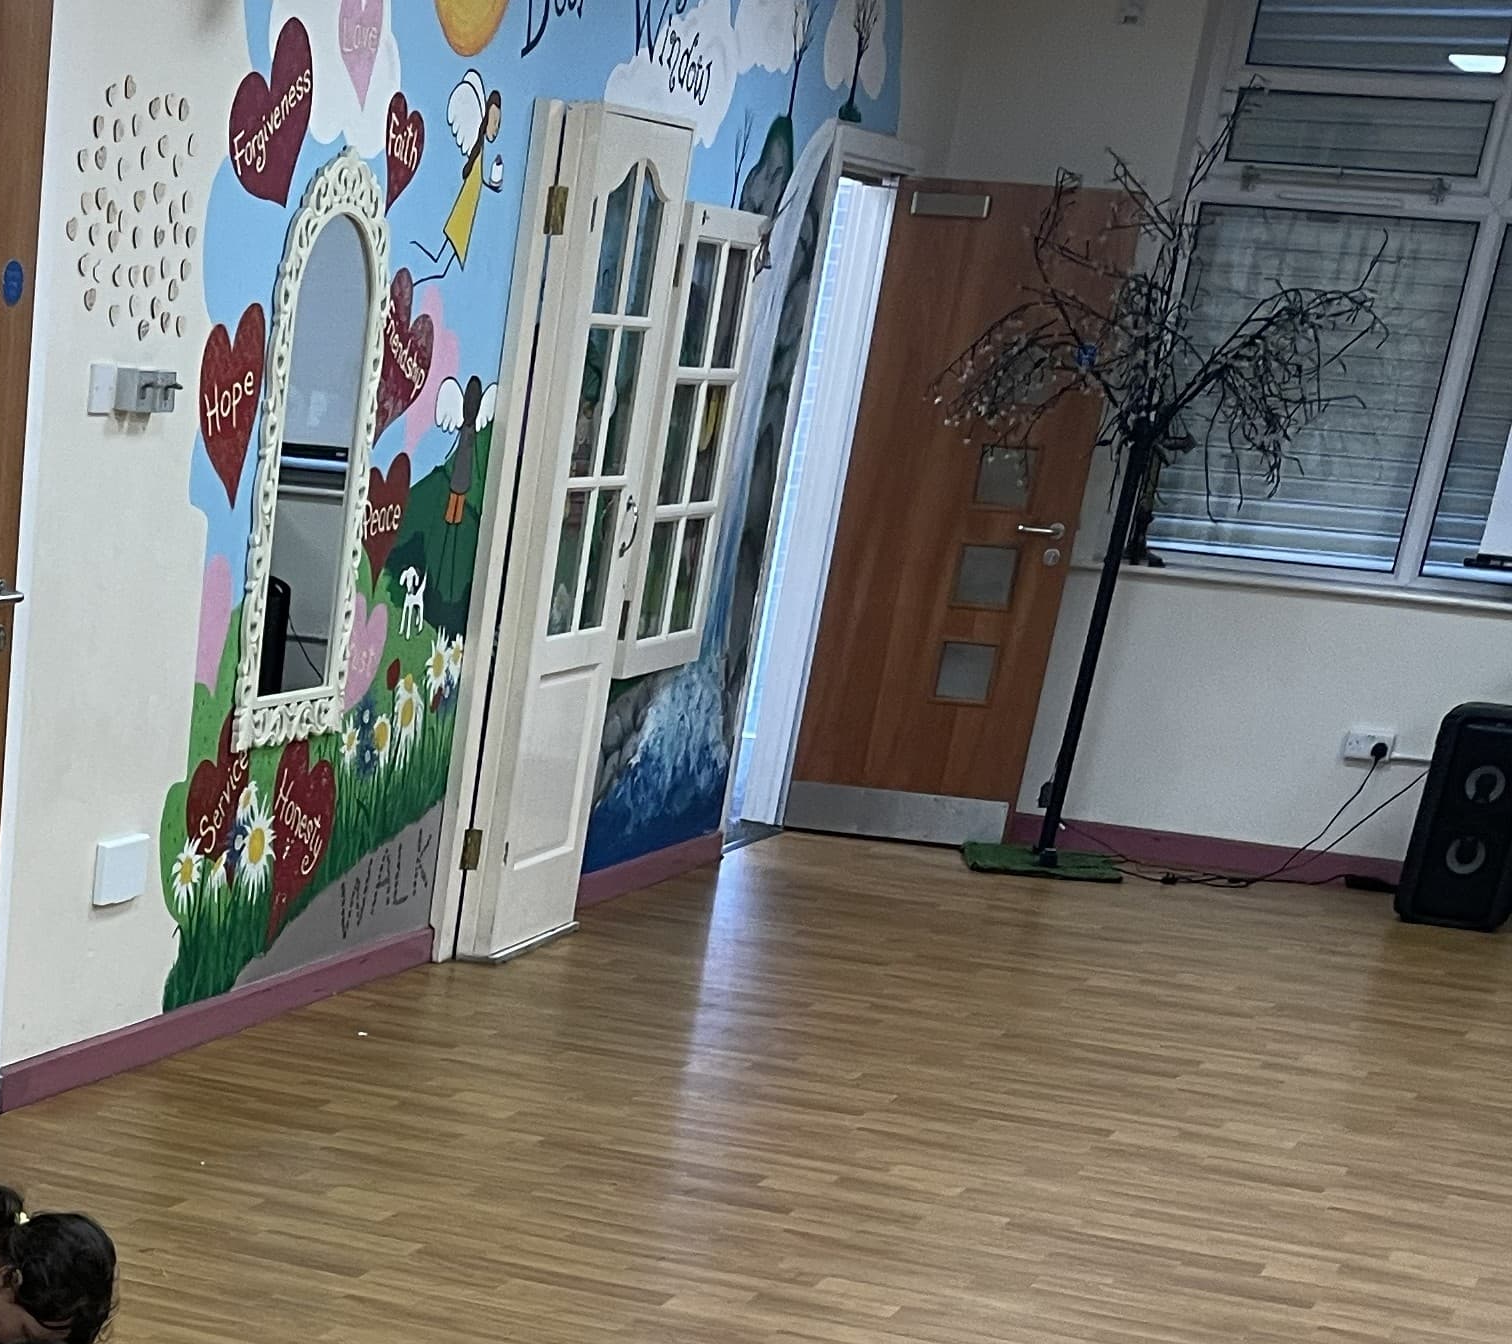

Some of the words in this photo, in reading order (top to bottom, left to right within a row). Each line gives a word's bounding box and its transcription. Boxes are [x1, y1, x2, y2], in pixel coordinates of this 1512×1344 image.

[343, 18, 379, 53] Love
[232, 68, 312, 177] Forgiveness
[388, 112, 419, 172] Faith
[204, 370, 255, 437] Hope
[363, 500, 401, 541] Peace
[199, 750, 249, 854] Service
[274, 767, 324, 876] Honesty
[339, 828, 433, 940] WALK
